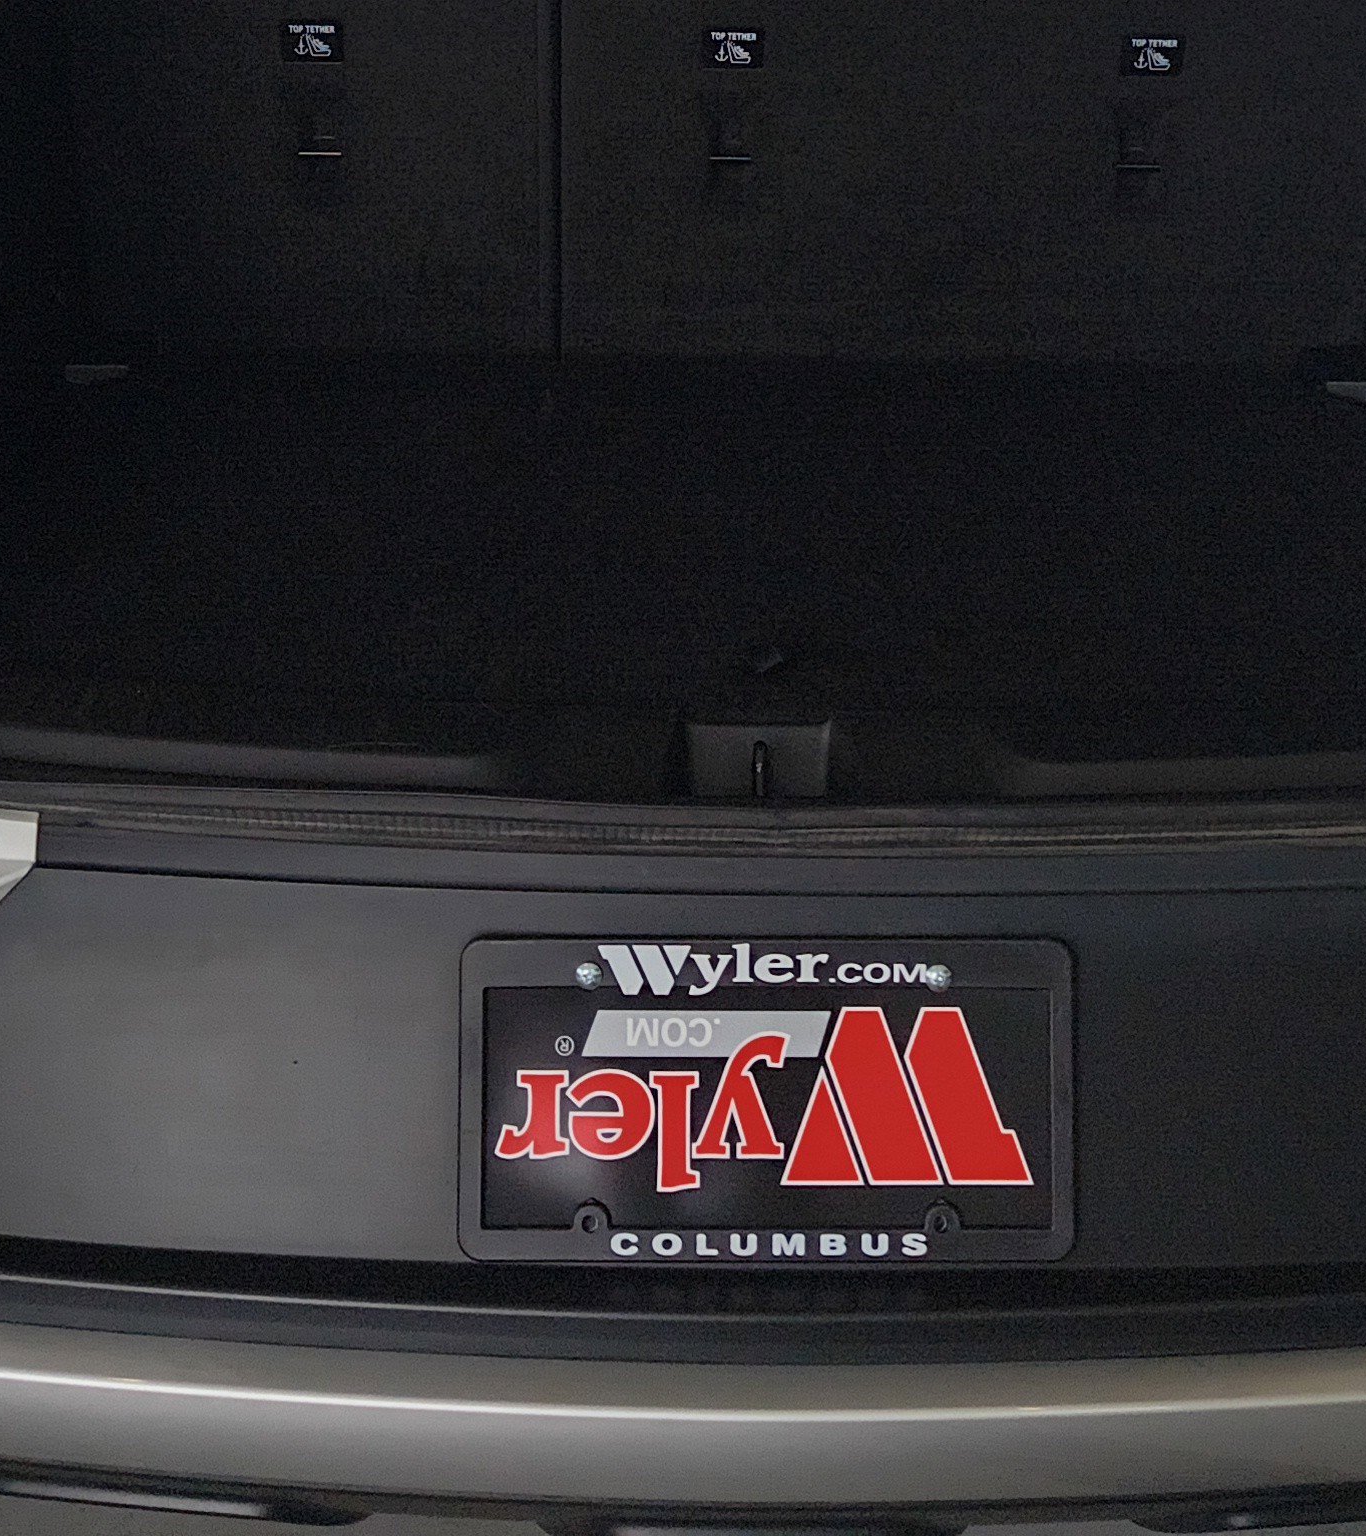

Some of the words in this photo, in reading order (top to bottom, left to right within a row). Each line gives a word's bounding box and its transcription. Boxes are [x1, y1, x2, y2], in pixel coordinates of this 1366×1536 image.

[288, 24, 304, 34] TOP
[304, 24, 336, 34] TETHER
[710, 31, 726, 41] TOP
[727, 31, 757, 41] TETHER
[1131, 38, 1147, 48] TOP
[1147, 38, 1178, 48] TETHER
[494, 1006, 1035, 1193] Wyler
[610, 1232, 929, 1257] COLUMBUS
